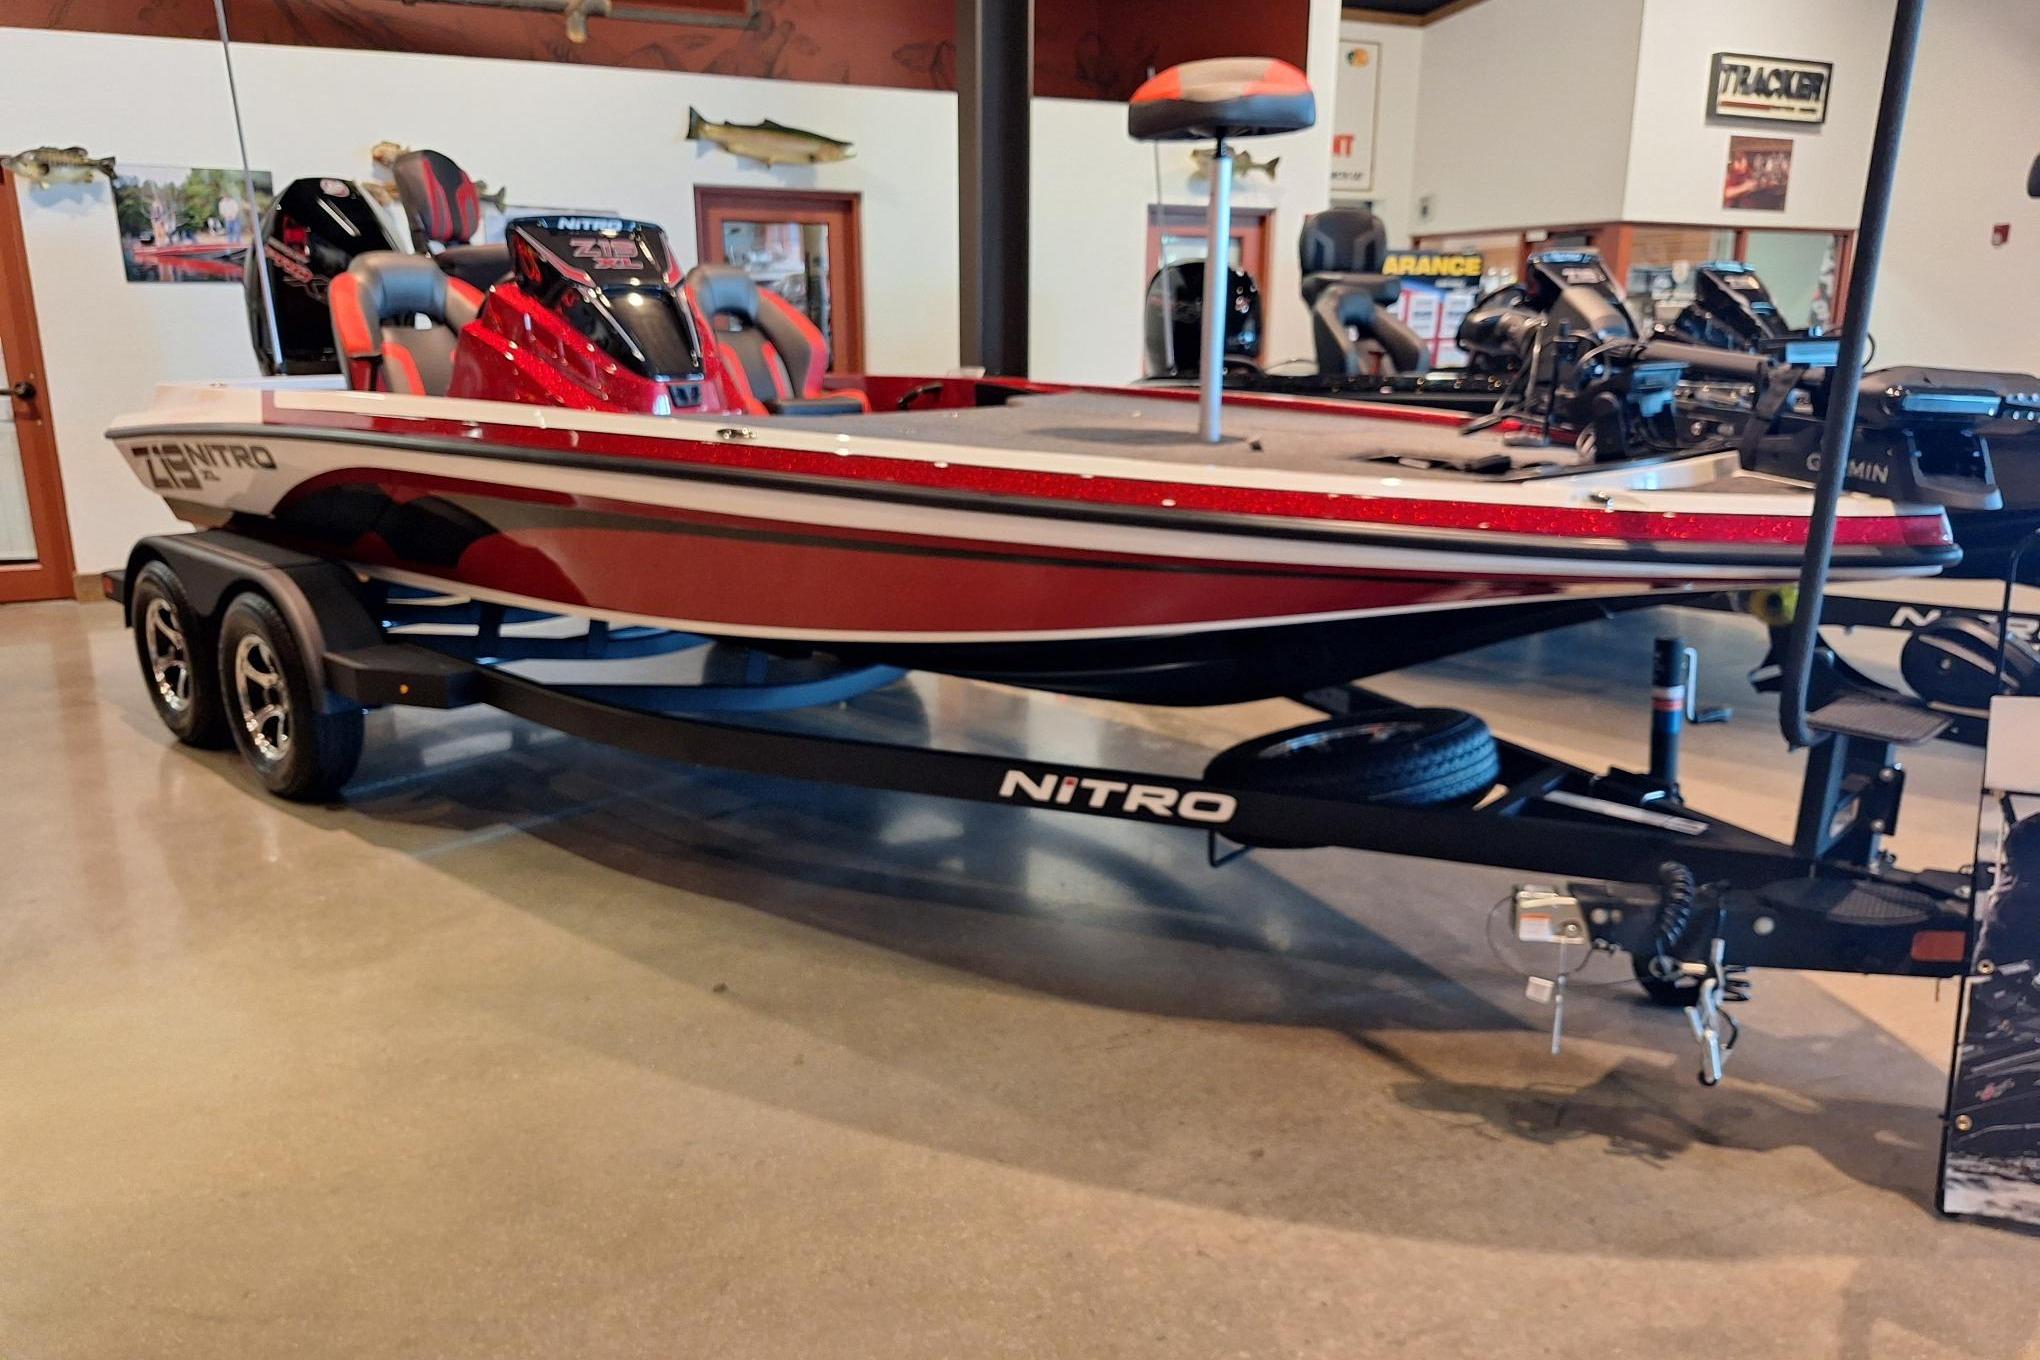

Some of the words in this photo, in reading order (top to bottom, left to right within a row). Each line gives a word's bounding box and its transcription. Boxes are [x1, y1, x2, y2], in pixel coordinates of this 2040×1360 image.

[1719, 63, 1825, 101] TRACKER
[557, 216, 623, 231] NITRO
[1382, 255, 1482, 276] ARANCE
[183, 444, 278, 470] NITRO
[1806, 453, 1889, 484] GMIN
